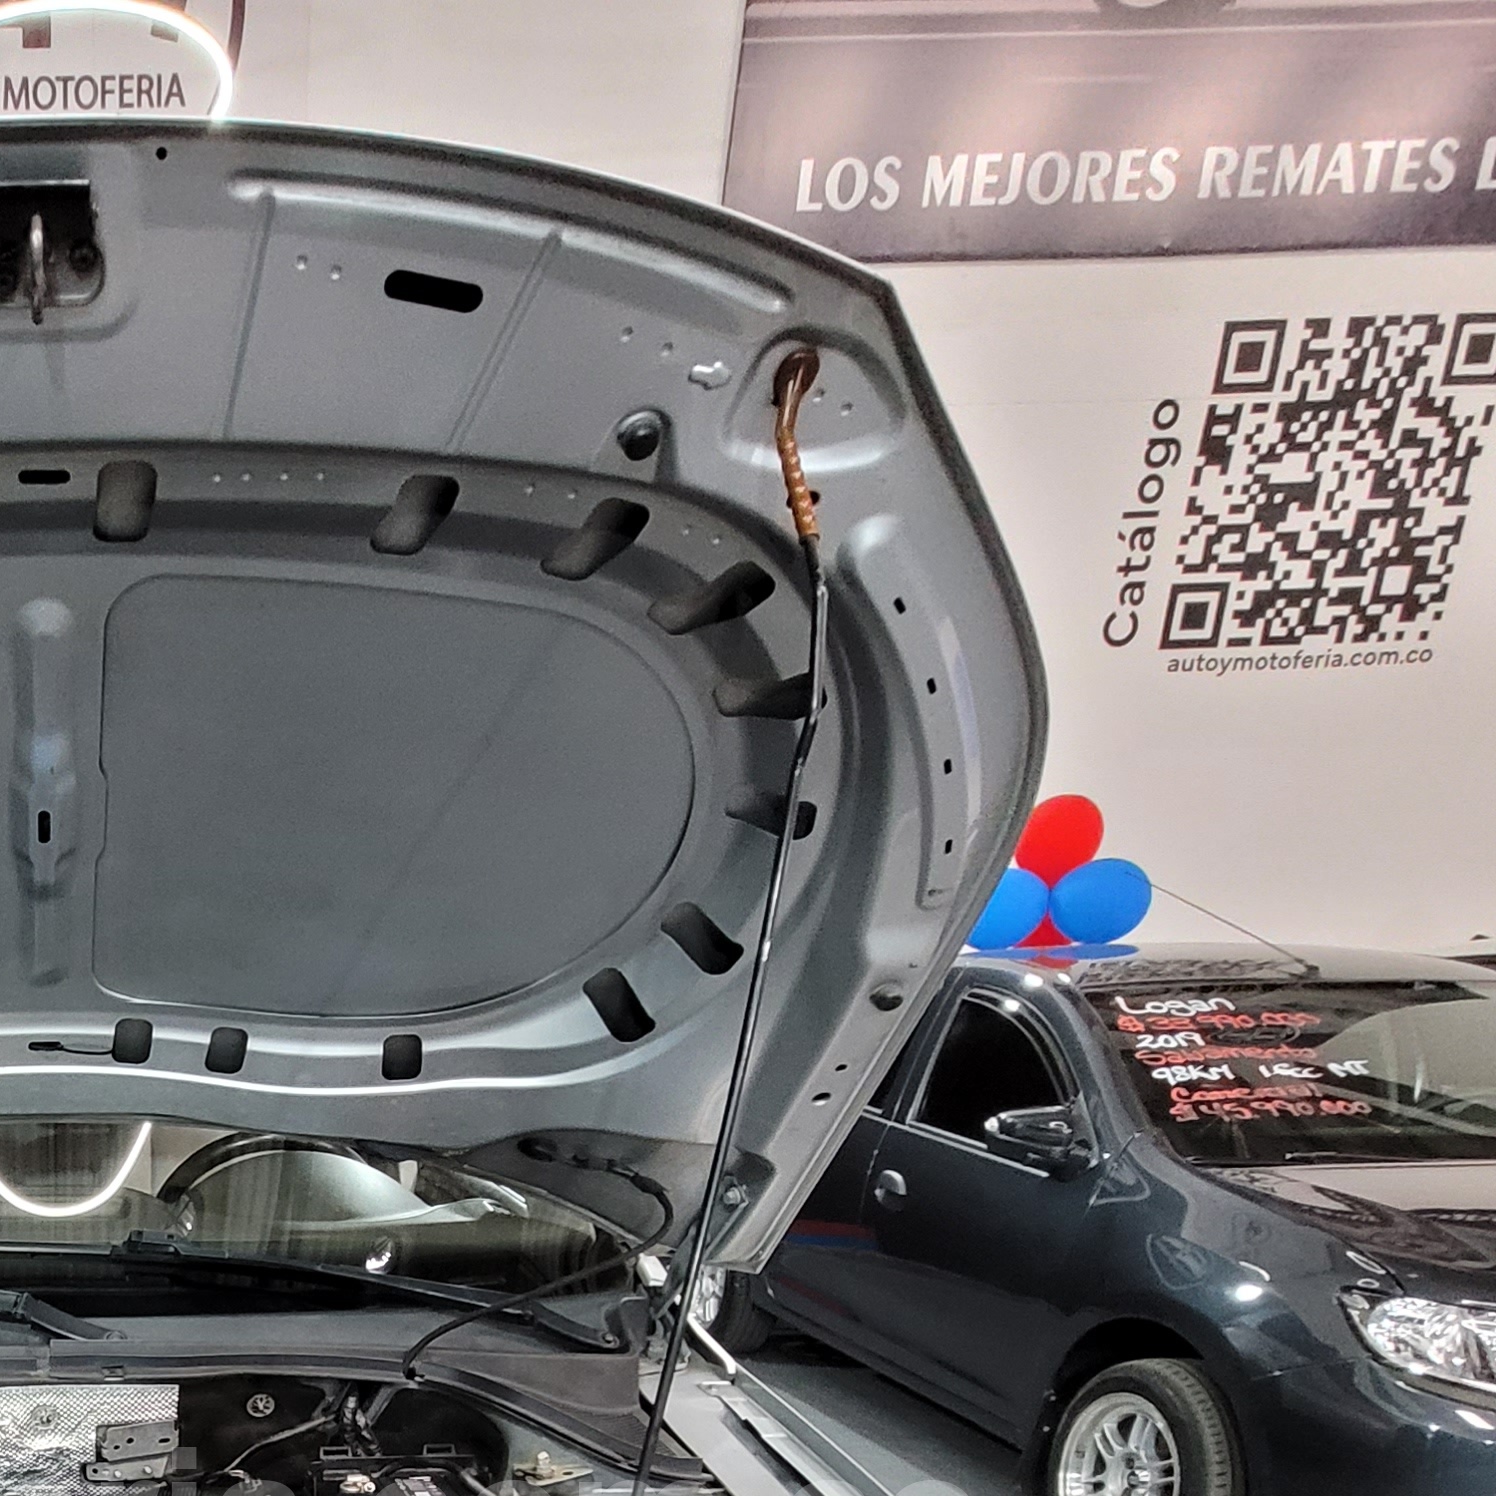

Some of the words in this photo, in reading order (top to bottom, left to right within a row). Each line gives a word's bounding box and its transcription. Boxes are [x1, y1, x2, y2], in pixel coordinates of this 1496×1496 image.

[3, 73, 186, 111] MOTOFERIA
[795, 156, 902, 212] LOS
[921, 146, 1181, 208] MEJORES
[1197, 137, 1459, 200] REMATES
[1102, 398, 1182, 648] Catálogo
[1167, 649, 1433, 676] autoymotoferia.com.co
[1115, 996, 1236, 1016] Logan
[1135, 1032, 1205, 1049] 2019
[1327, 1059, 1369, 1078] MT
